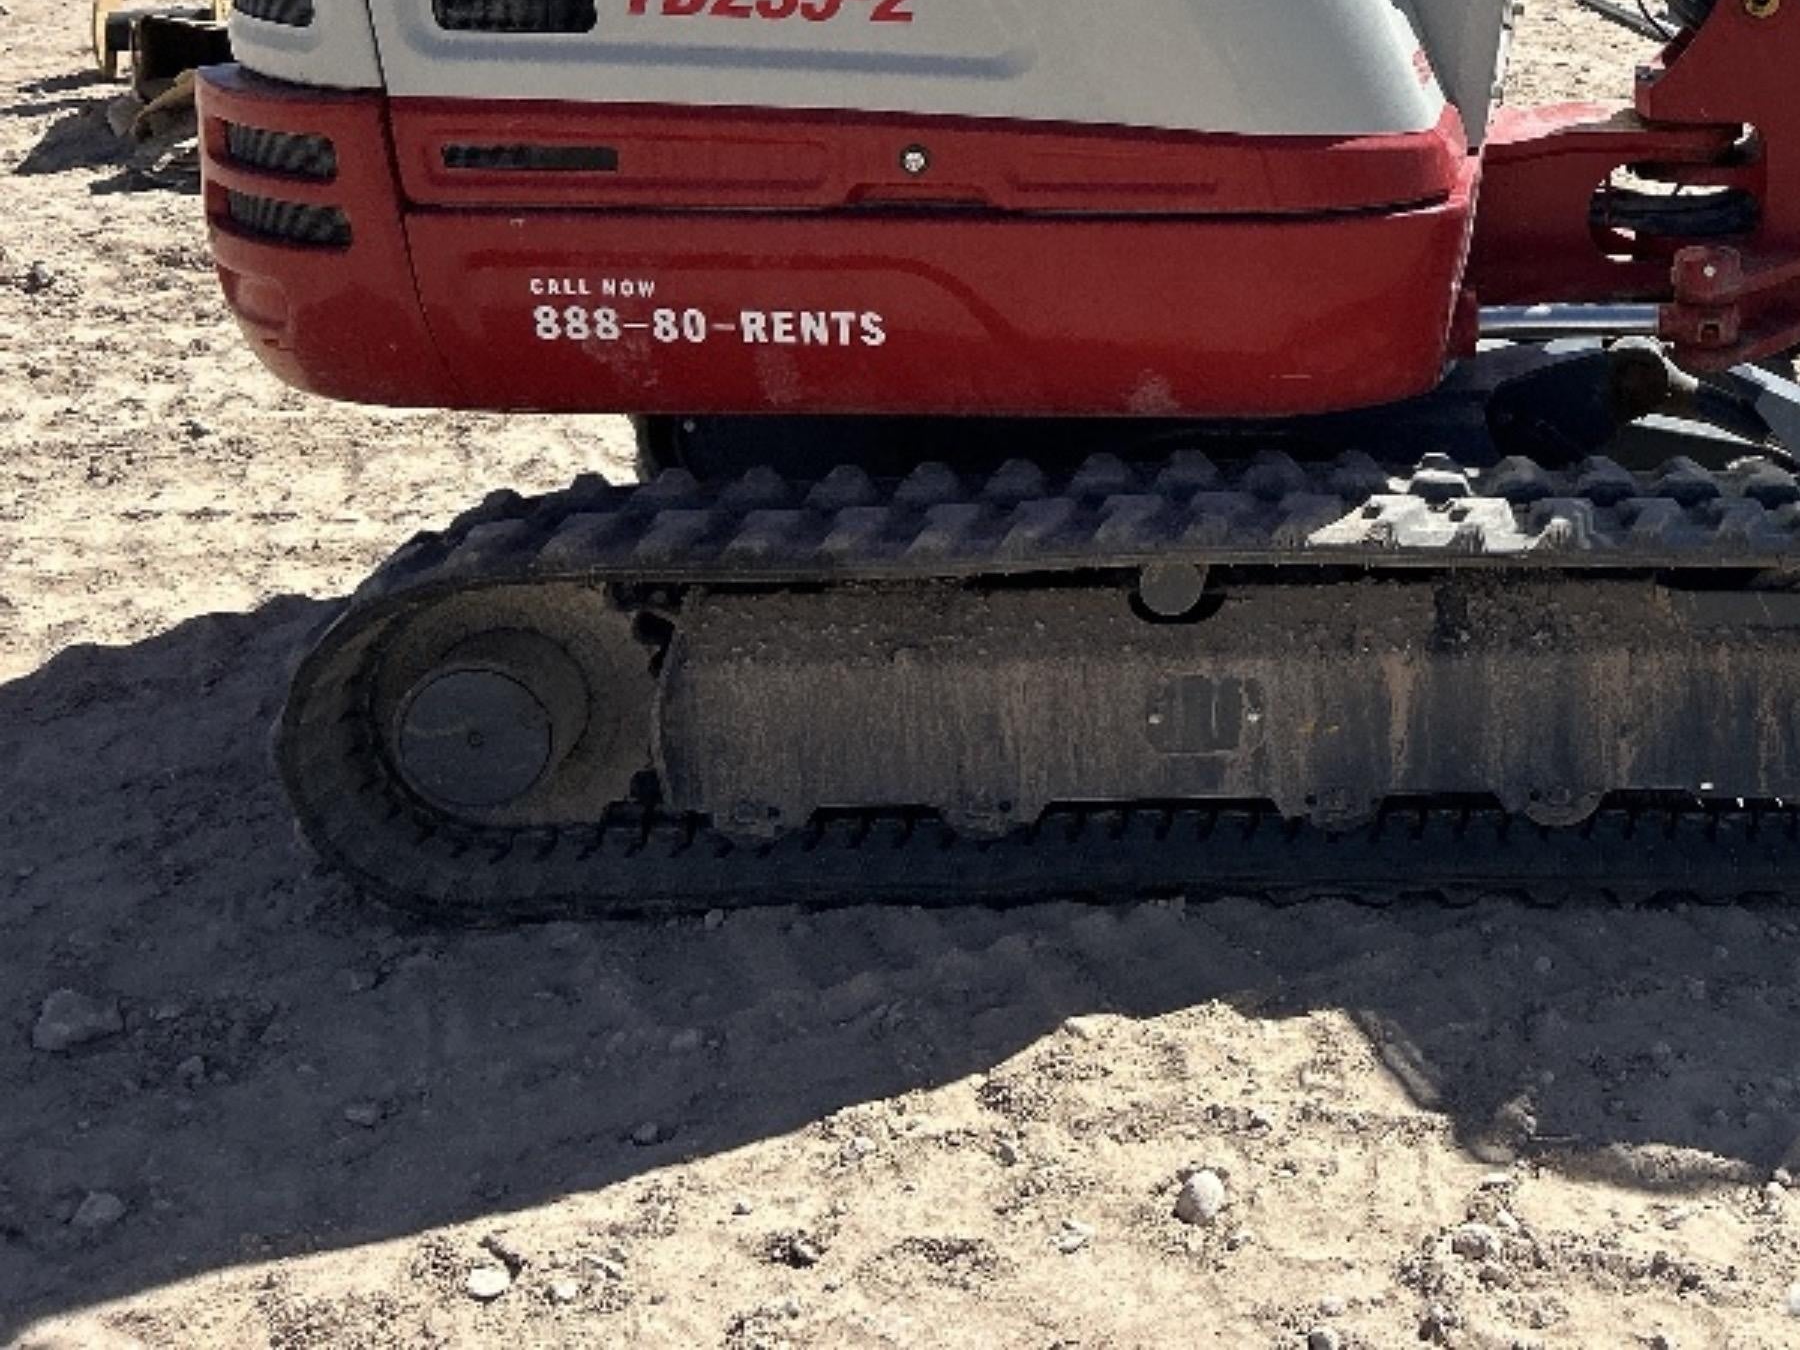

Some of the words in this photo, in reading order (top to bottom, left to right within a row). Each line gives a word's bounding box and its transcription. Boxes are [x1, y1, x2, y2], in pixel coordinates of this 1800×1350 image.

[529, 278, 592, 297] CALL
[602, 278, 656, 298] NOW
[533, 305, 887, 347] 888-80-RENTS
